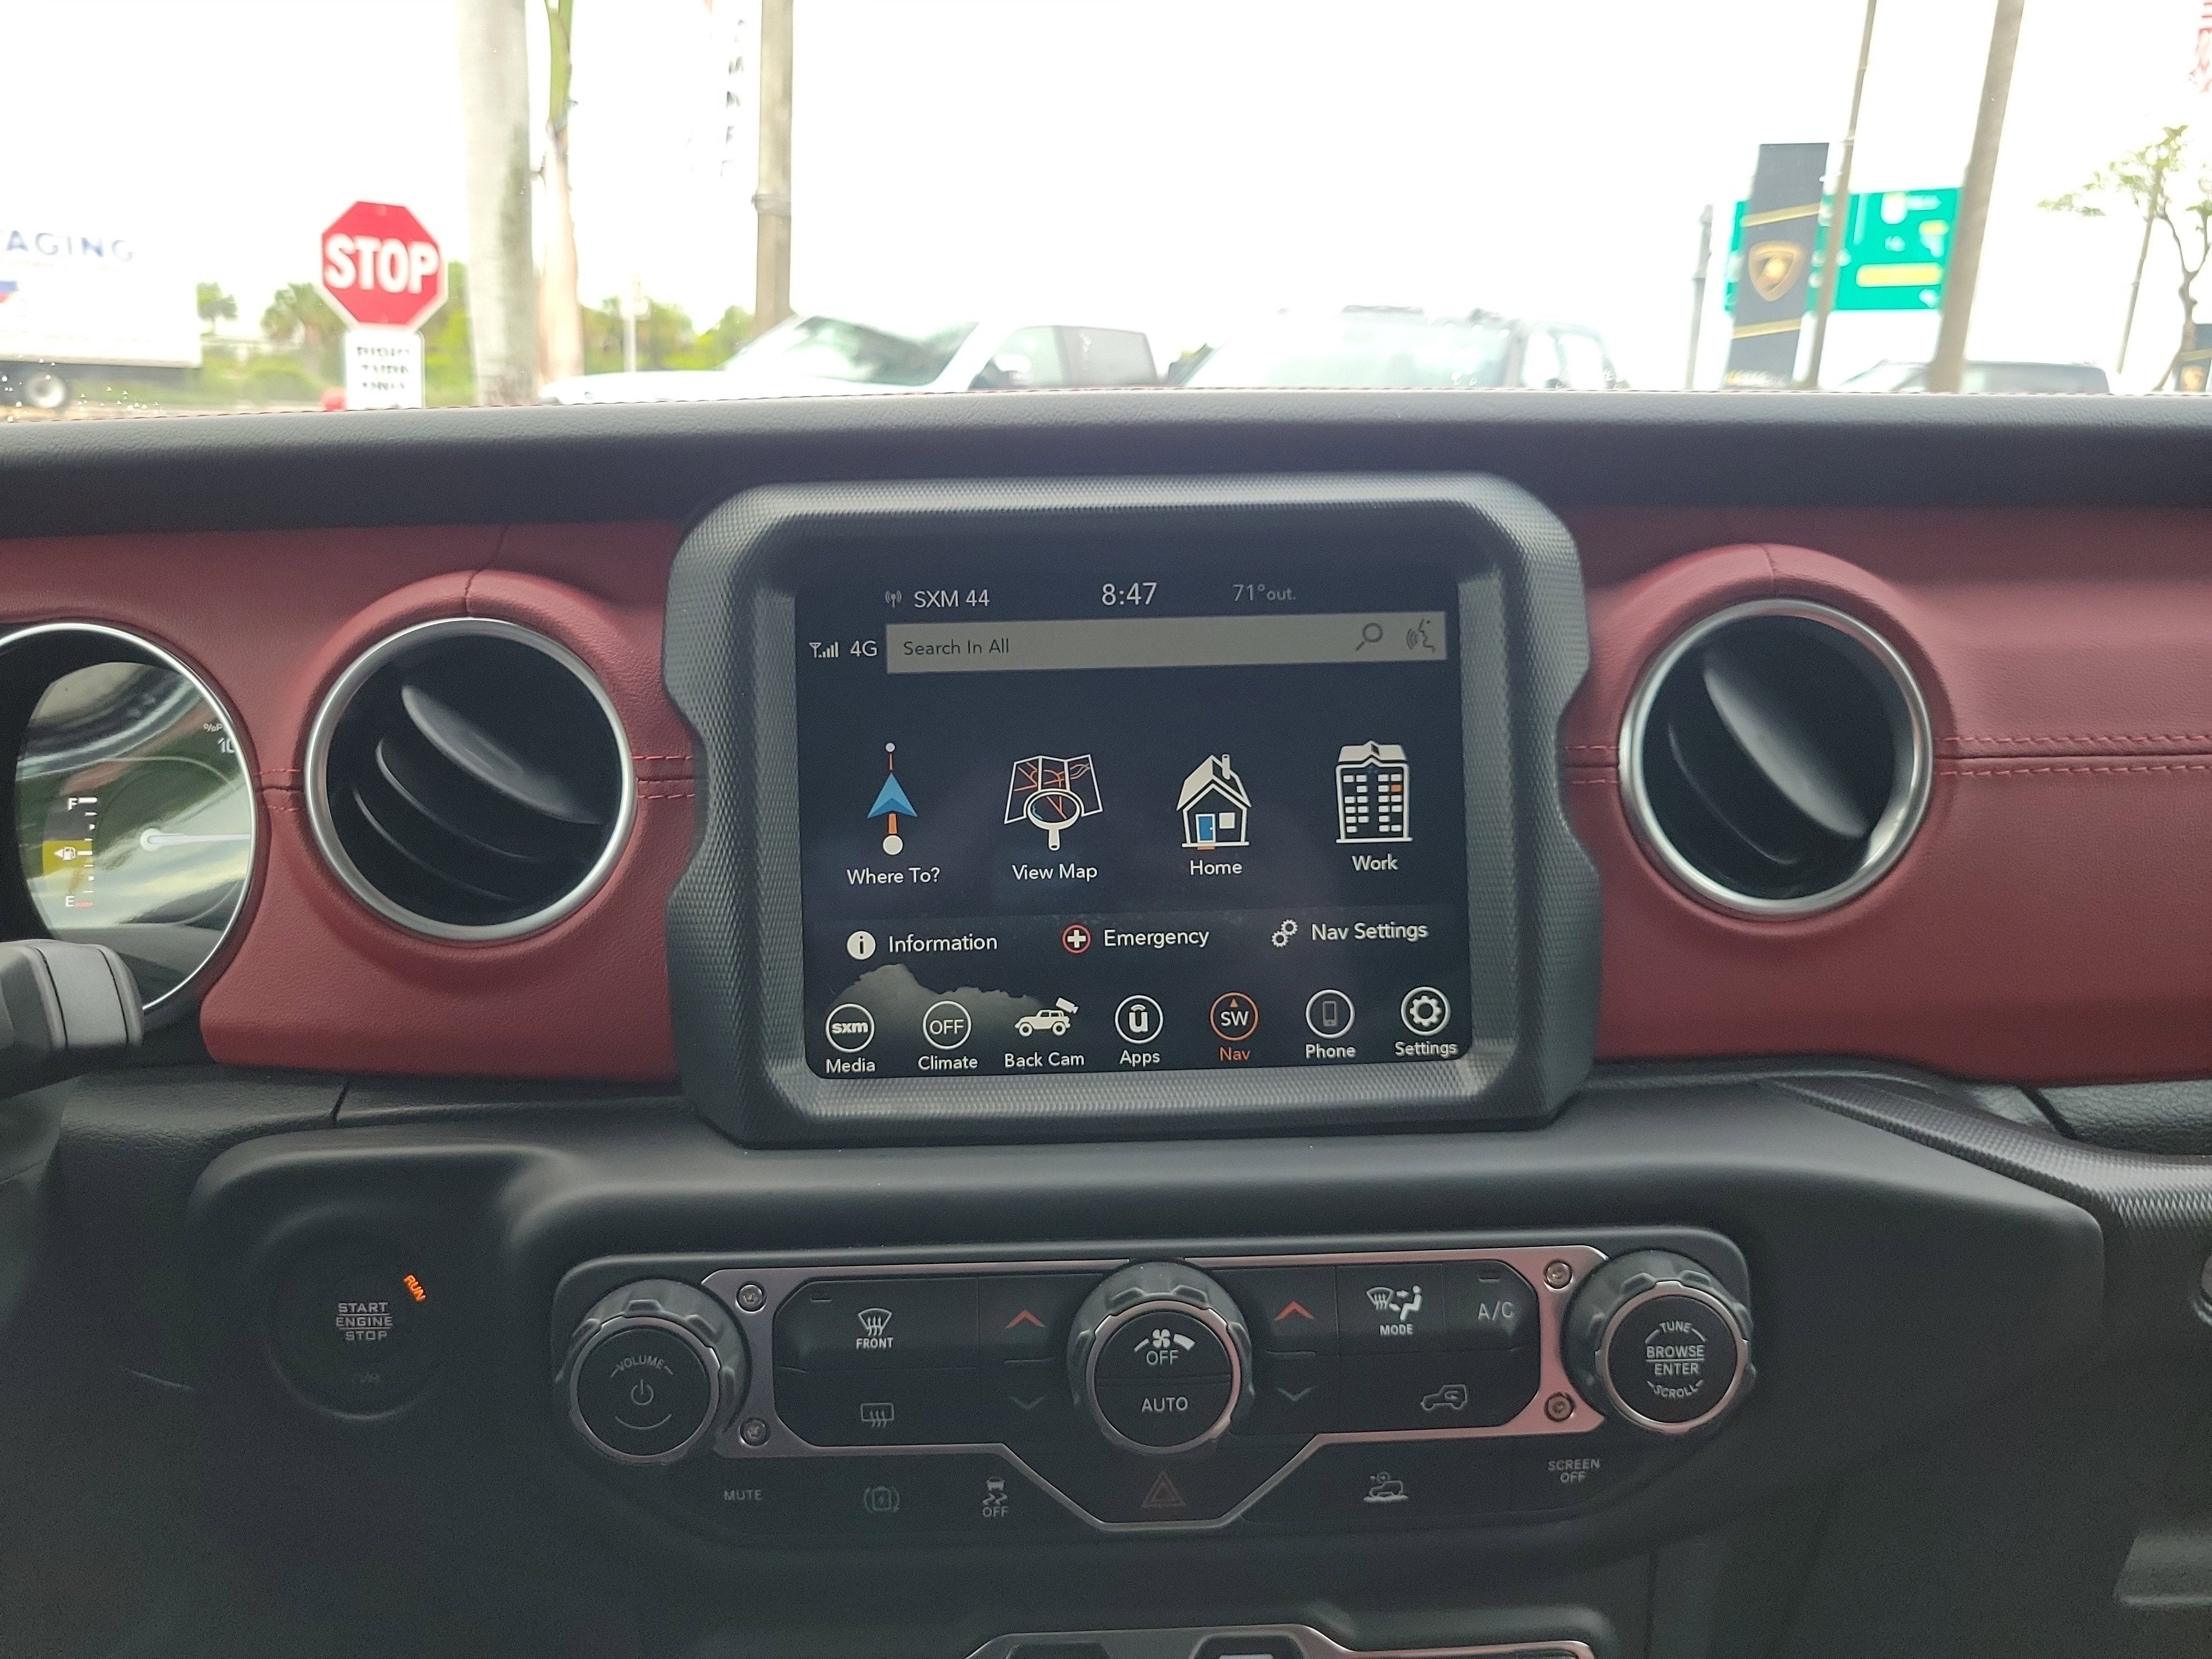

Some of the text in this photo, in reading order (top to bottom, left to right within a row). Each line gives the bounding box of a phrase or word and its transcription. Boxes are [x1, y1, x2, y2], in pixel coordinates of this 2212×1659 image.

[324, 233, 439, 294] STOP
[914, 590, 990, 608] SXM 44
[1102, 583, 1157, 606] 8:47
[850, 641, 878, 657] 4G
[904, 638, 1009, 655] Search In All
[68, 797, 78, 810] F
[1190, 860, 1243, 875] Home
[1352, 854, 1398, 871] Work
[847, 867, 940, 885] Where To?
[1012, 864, 1098, 882] View Map
[65, 895, 75, 907] E
[1104, 928, 1210, 949] Emergency
[1312, 922, 1429, 942] Nav Settings
[889, 934, 998, 953] Information
[1221, 1011, 1249, 1026] SW
[831, 1020, 868, 1034] sxm
[929, 1019, 965, 1035] OFF
[1219, 1047, 1251, 1062] Nav
[1305, 1043, 1356, 1059] Phone
[1395, 1041, 1459, 1059] Settings
[826, 1058, 876, 1073] Media
[918, 1055, 978, 1070] Climate
[1005, 1052, 1085, 1068] Back Cam
[1119, 1051, 1161, 1069] Apps
[404, 1274, 426, 1302] RUN
[338, 1302, 388, 1313] START
[1477, 1301, 1516, 1321] A/C
[336, 1317, 393, 1327] ENGINE
[1380, 1323, 1414, 1336] MODE
[1660, 1321, 1693, 1334] TUNE
[346, 1331, 387, 1341] STOP
[856, 1337, 894, 1350] FRONT
[1146, 1350, 1179, 1366] OFF
[1646, 1345, 1705, 1359] BROWSE
[616, 1355, 665, 1372] VOLUME
[1654, 1362, 1699, 1376] ENTER
[1654, 1385, 1699, 1398] SCROLL
[1141, 1396, 1189, 1413] AUTO
[1548, 1458, 1600, 1471] SCREEN
[1560, 1472, 1586, 1483] OFF
[724, 1489, 763, 1501] MUTE
[981, 1507, 1008, 1518] OFF
